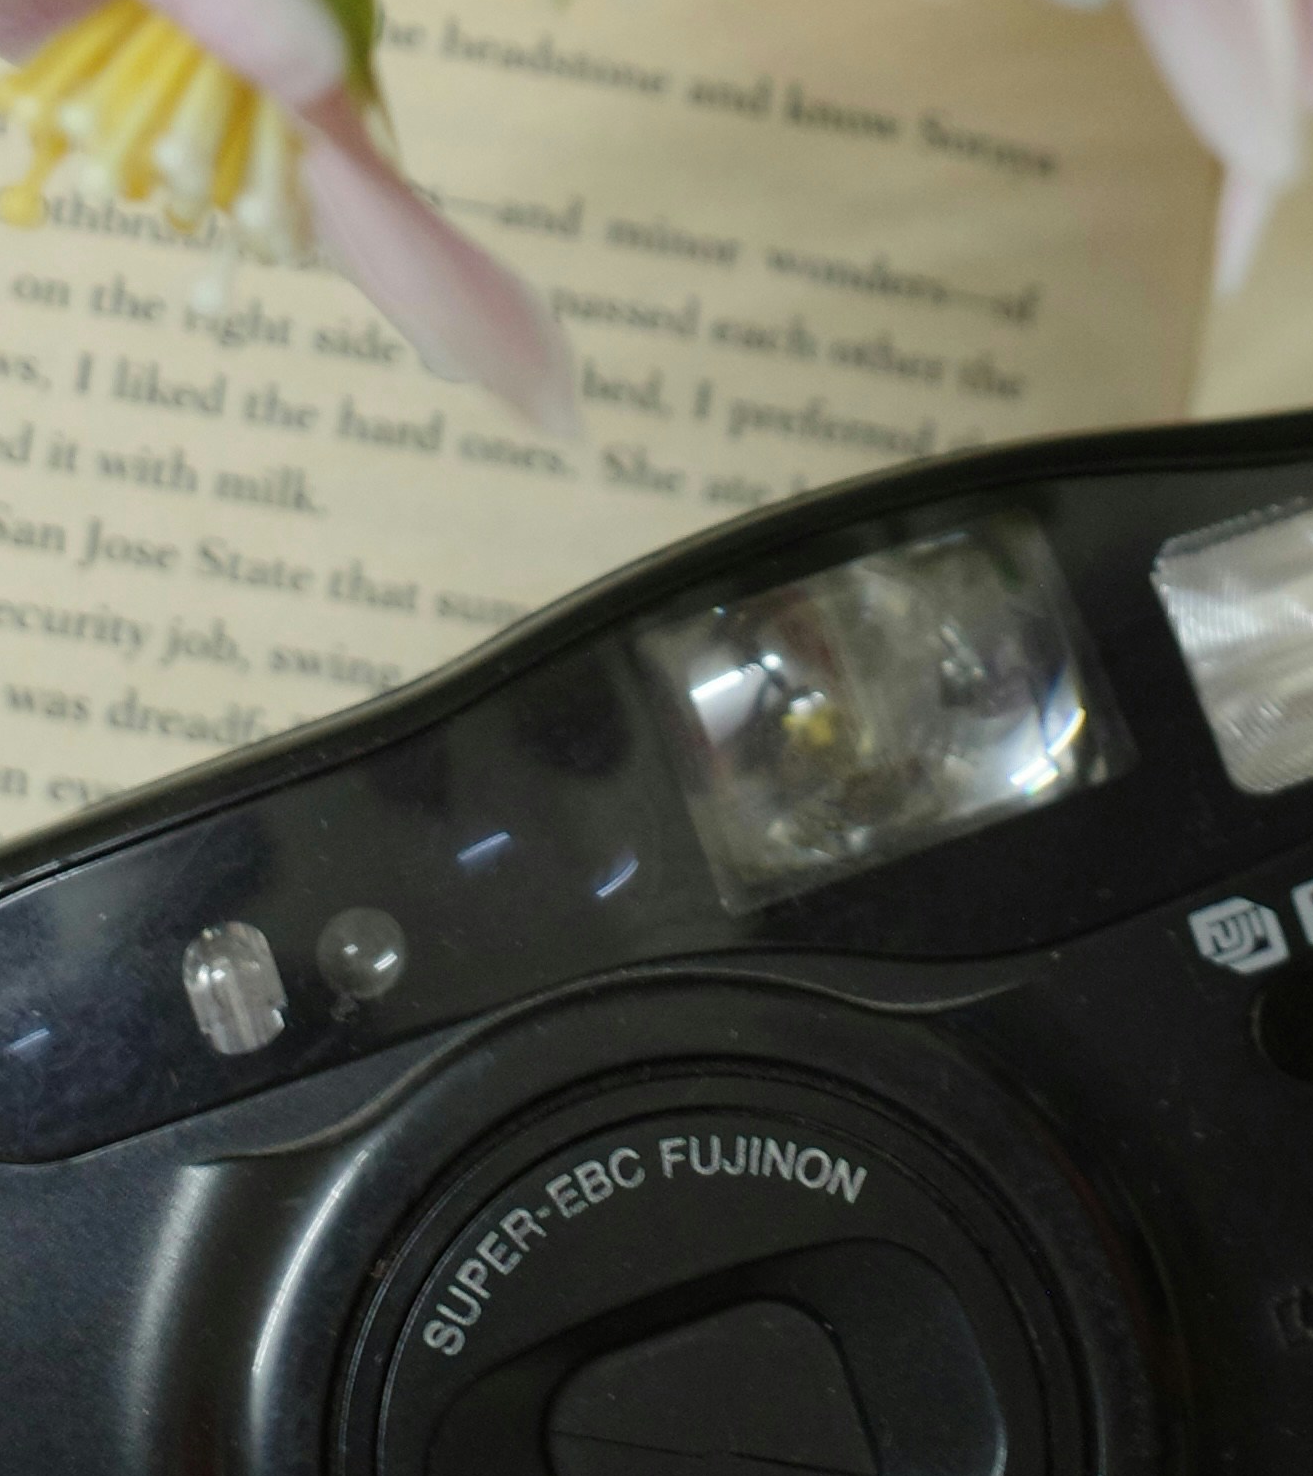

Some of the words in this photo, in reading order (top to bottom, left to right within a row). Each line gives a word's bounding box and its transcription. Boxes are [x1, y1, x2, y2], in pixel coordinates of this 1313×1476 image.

[9, 274, 71, 308] on
[88, 275, 166, 324] the
[77, 517, 179, 573] Jose
[422, 1146, 646, 1355] SUPER-EBC
[658, 1134, 868, 1204] FUJINON
